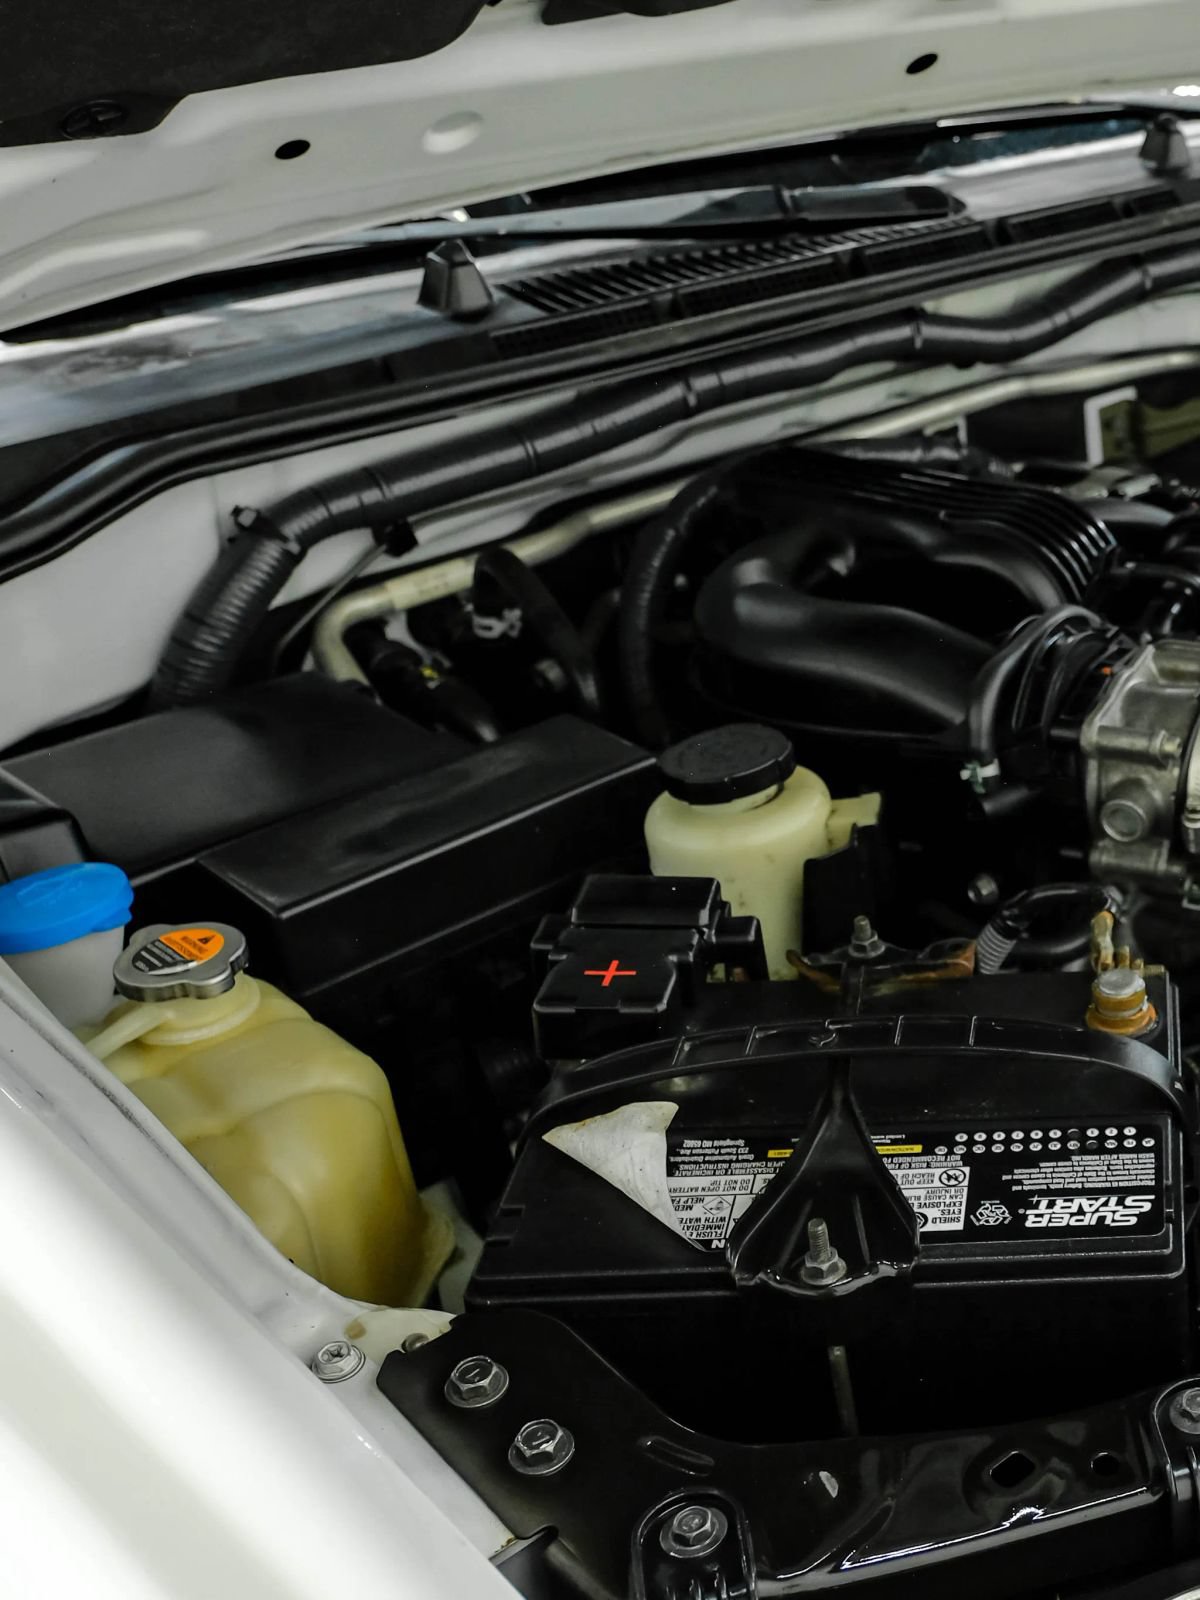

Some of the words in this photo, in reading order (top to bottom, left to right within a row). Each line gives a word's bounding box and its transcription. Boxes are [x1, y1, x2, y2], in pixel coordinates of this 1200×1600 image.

[892, 1155, 945, 1163] RECOMMENDED
[678, 1163, 730, 1171] INSTRUCTIONS.
[731, 1161, 766, 1169] CHARGING
[727, 1167, 774, 1175] DISASSEMBLE
[683, 1197, 704, 1205] HELP
[916, 1201, 962, 1209] EXPLOSIVE
[1025, 1195, 1155, 1214] START
[704, 1216, 726, 1224] WITH
[932, 1216, 961, 1224] SHIELD
[1025, 1210, 1140, 1228] SUPER
[680, 1223, 725, 1231] IMMEDIAT
